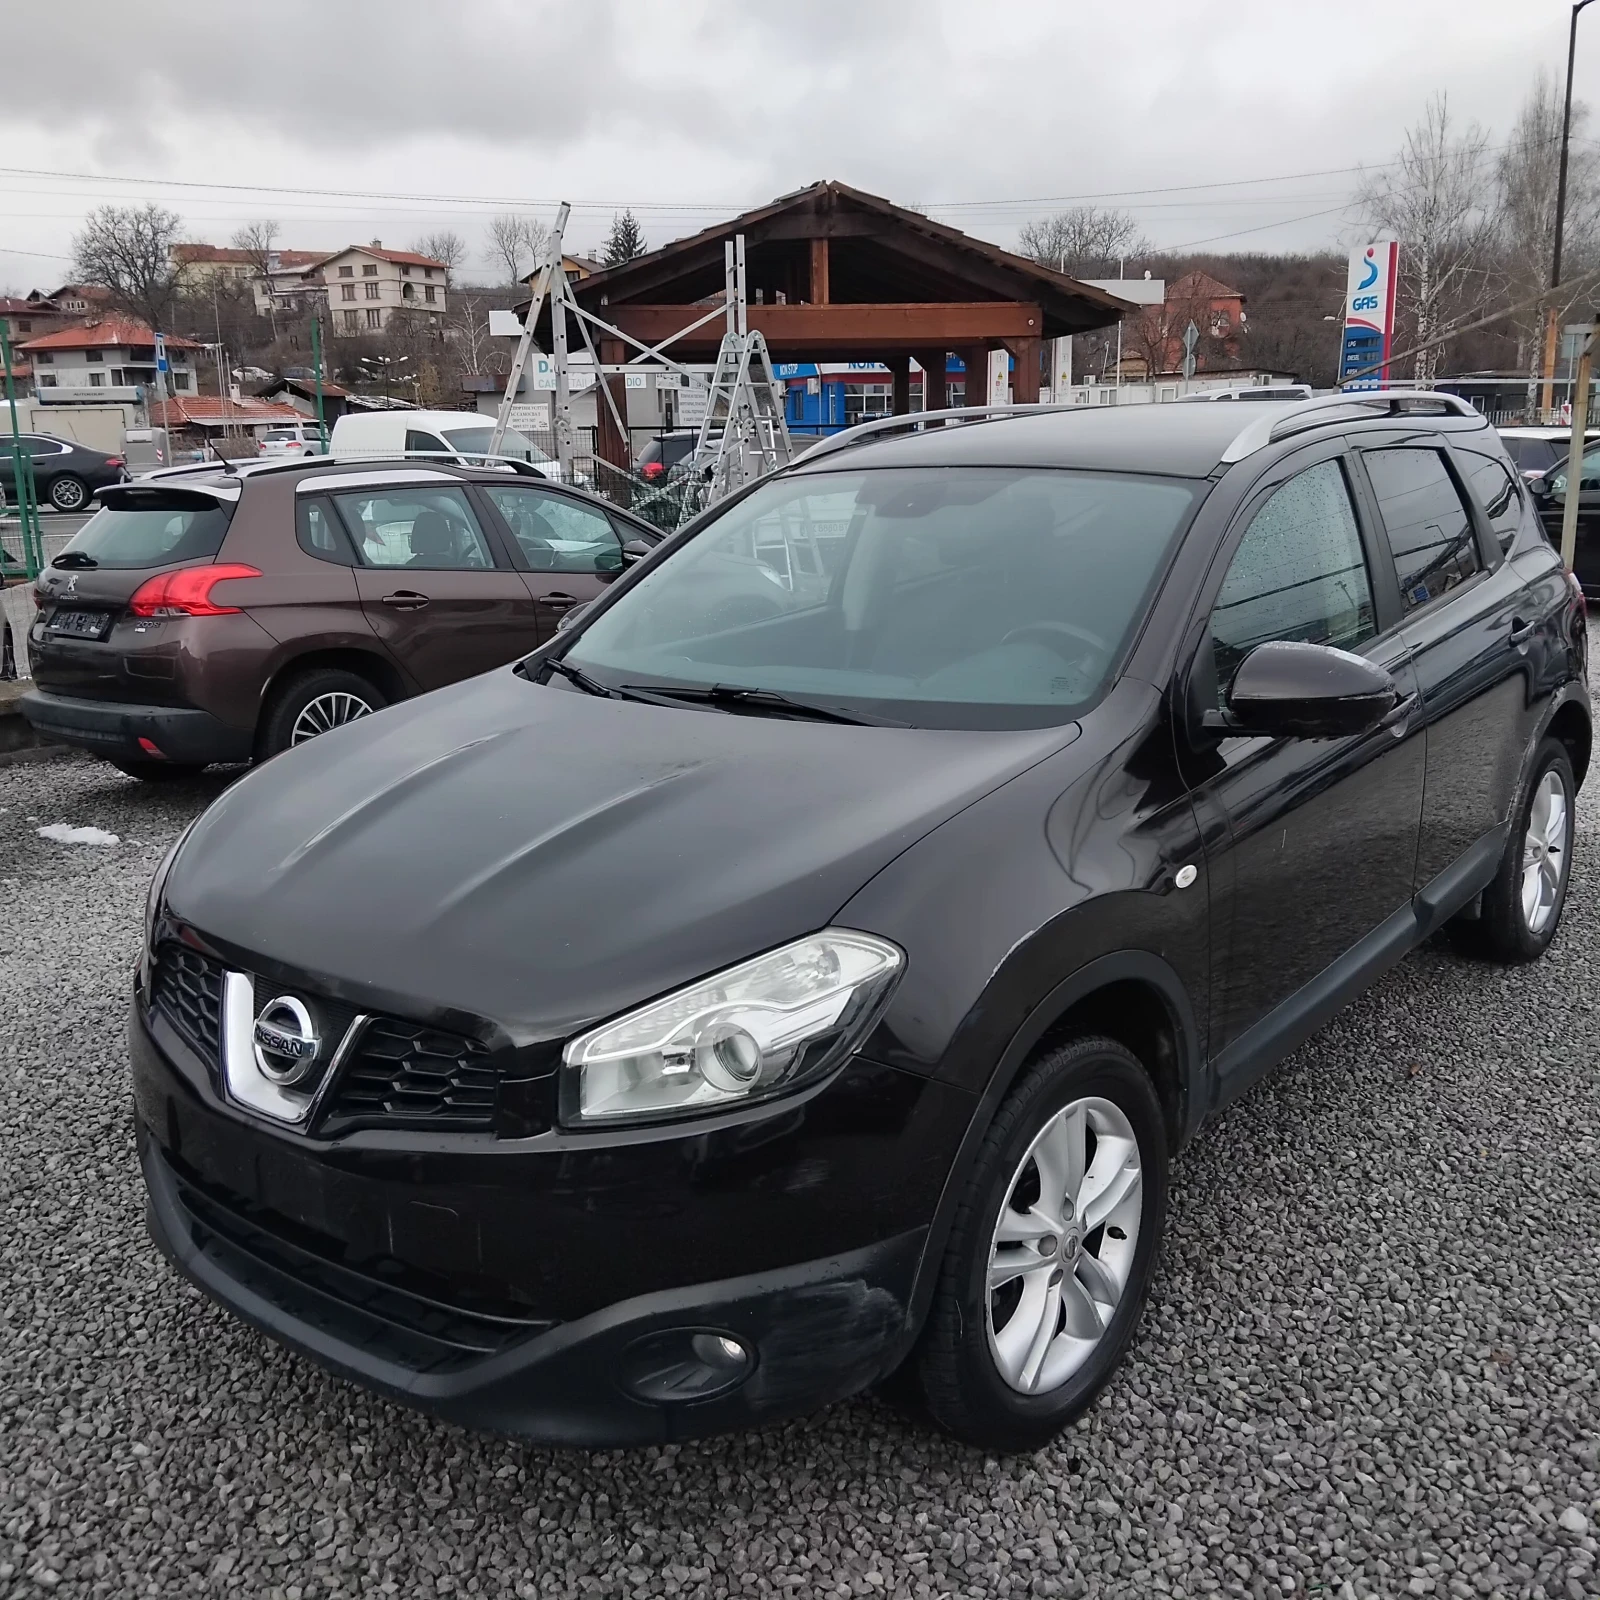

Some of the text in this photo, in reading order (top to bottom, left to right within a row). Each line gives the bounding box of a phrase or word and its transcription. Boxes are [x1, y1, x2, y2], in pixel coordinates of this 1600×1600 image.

[1352, 296, 1378, 311] GAS
[1347, 340, 1357, 348] LPG
[779, 363, 798, 376] NON STOP
[255, 1024, 304, 1059] NISSAN
